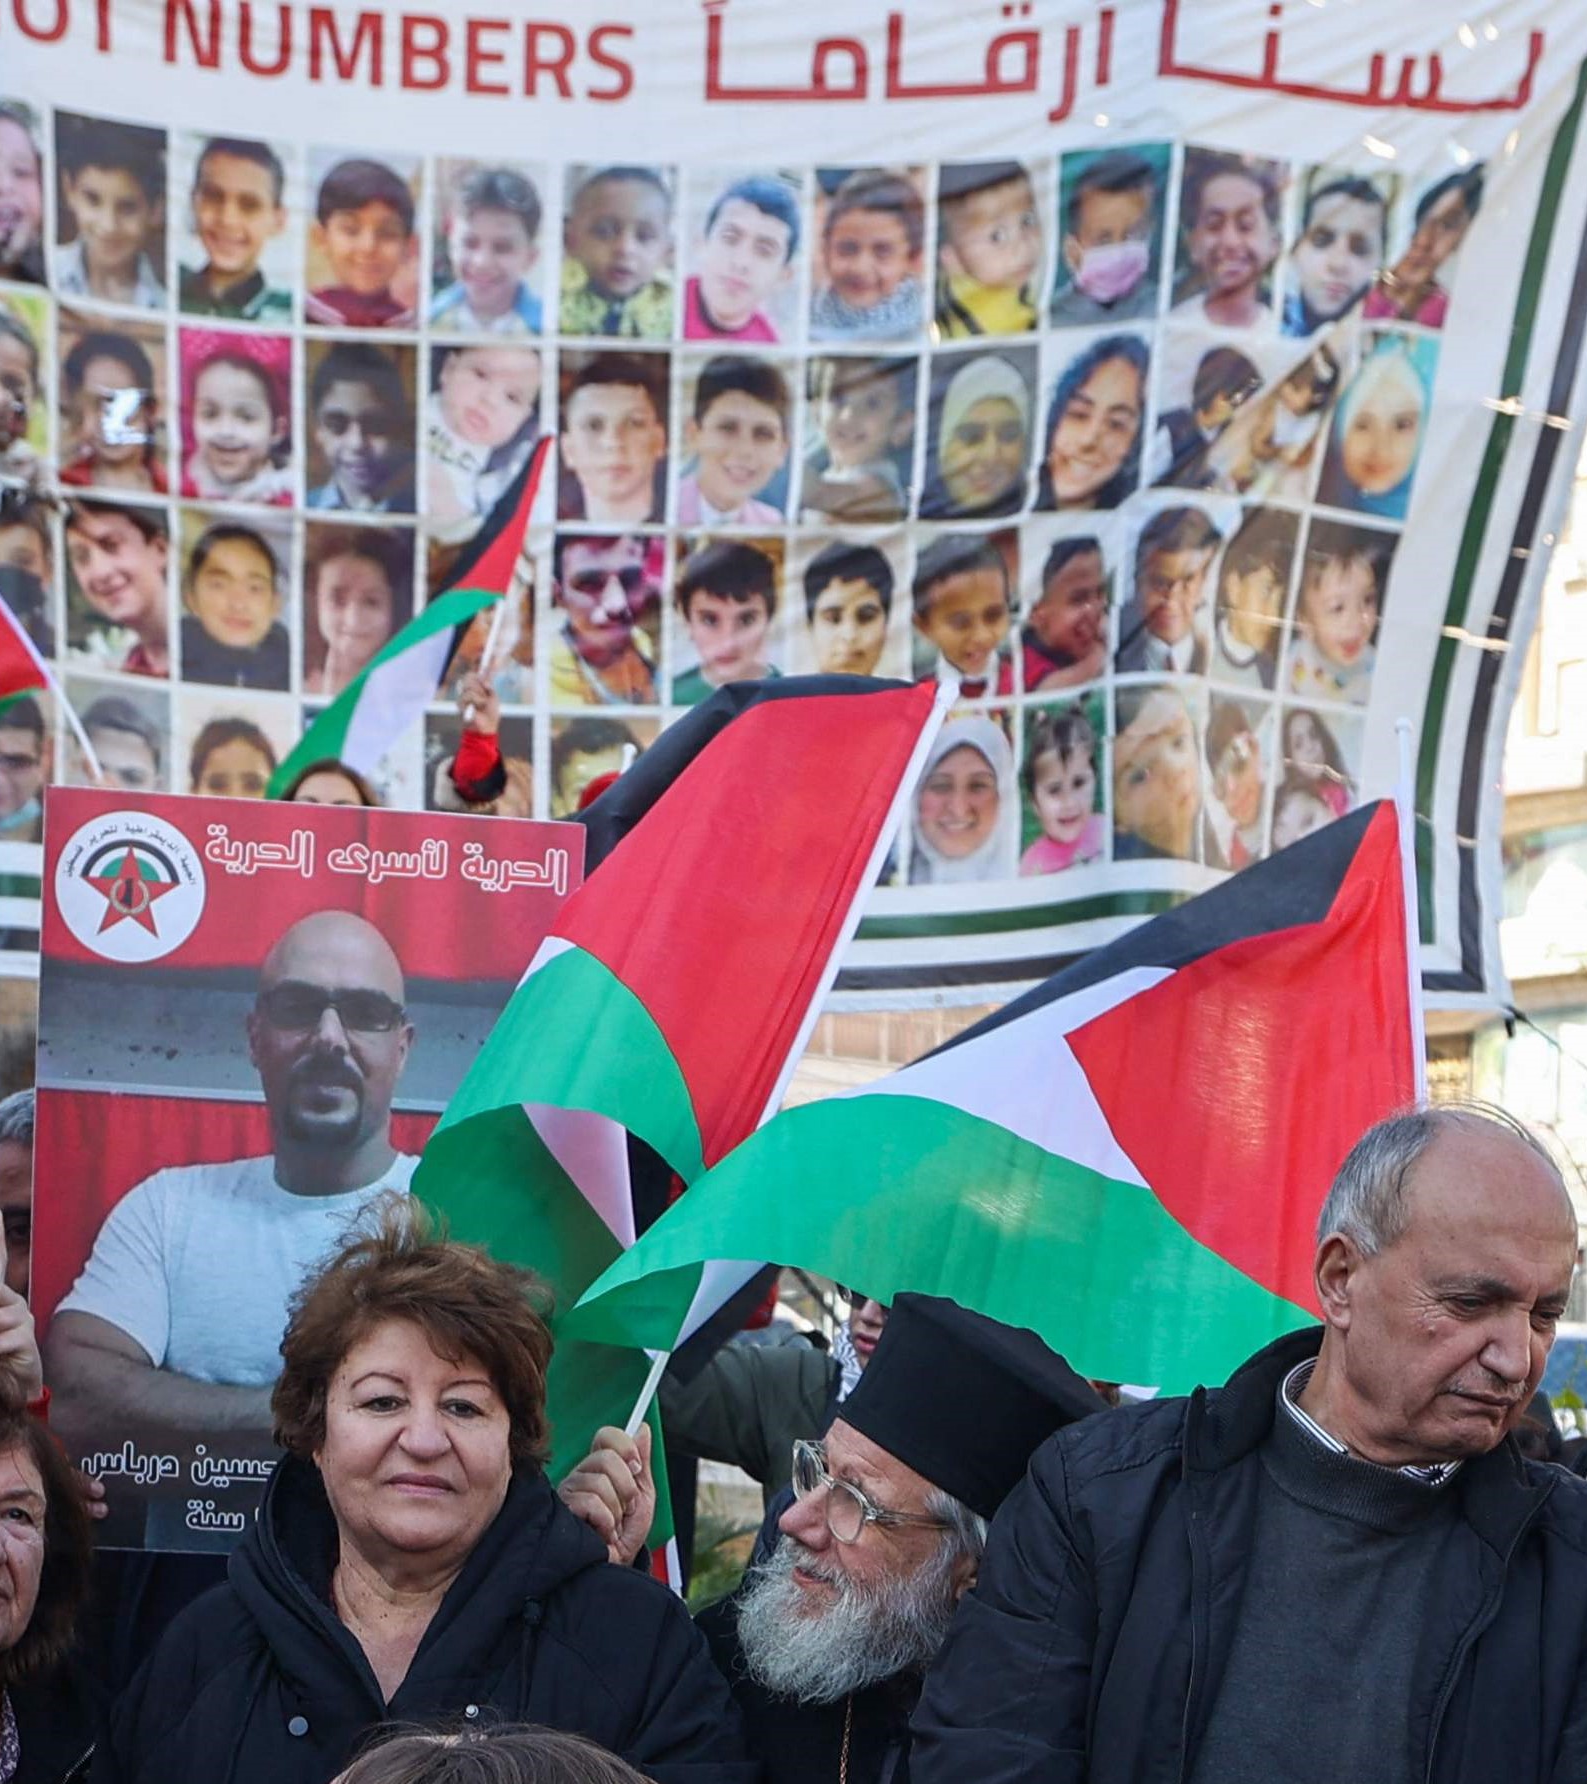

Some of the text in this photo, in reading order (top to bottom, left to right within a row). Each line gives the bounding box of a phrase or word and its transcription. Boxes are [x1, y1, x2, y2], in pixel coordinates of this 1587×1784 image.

[161, 0, 636, 102] NUMBERS
[204, 823, 568, 896] الحرية لأسرى الحرية
[185, 1499, 246, 1532] سنة
